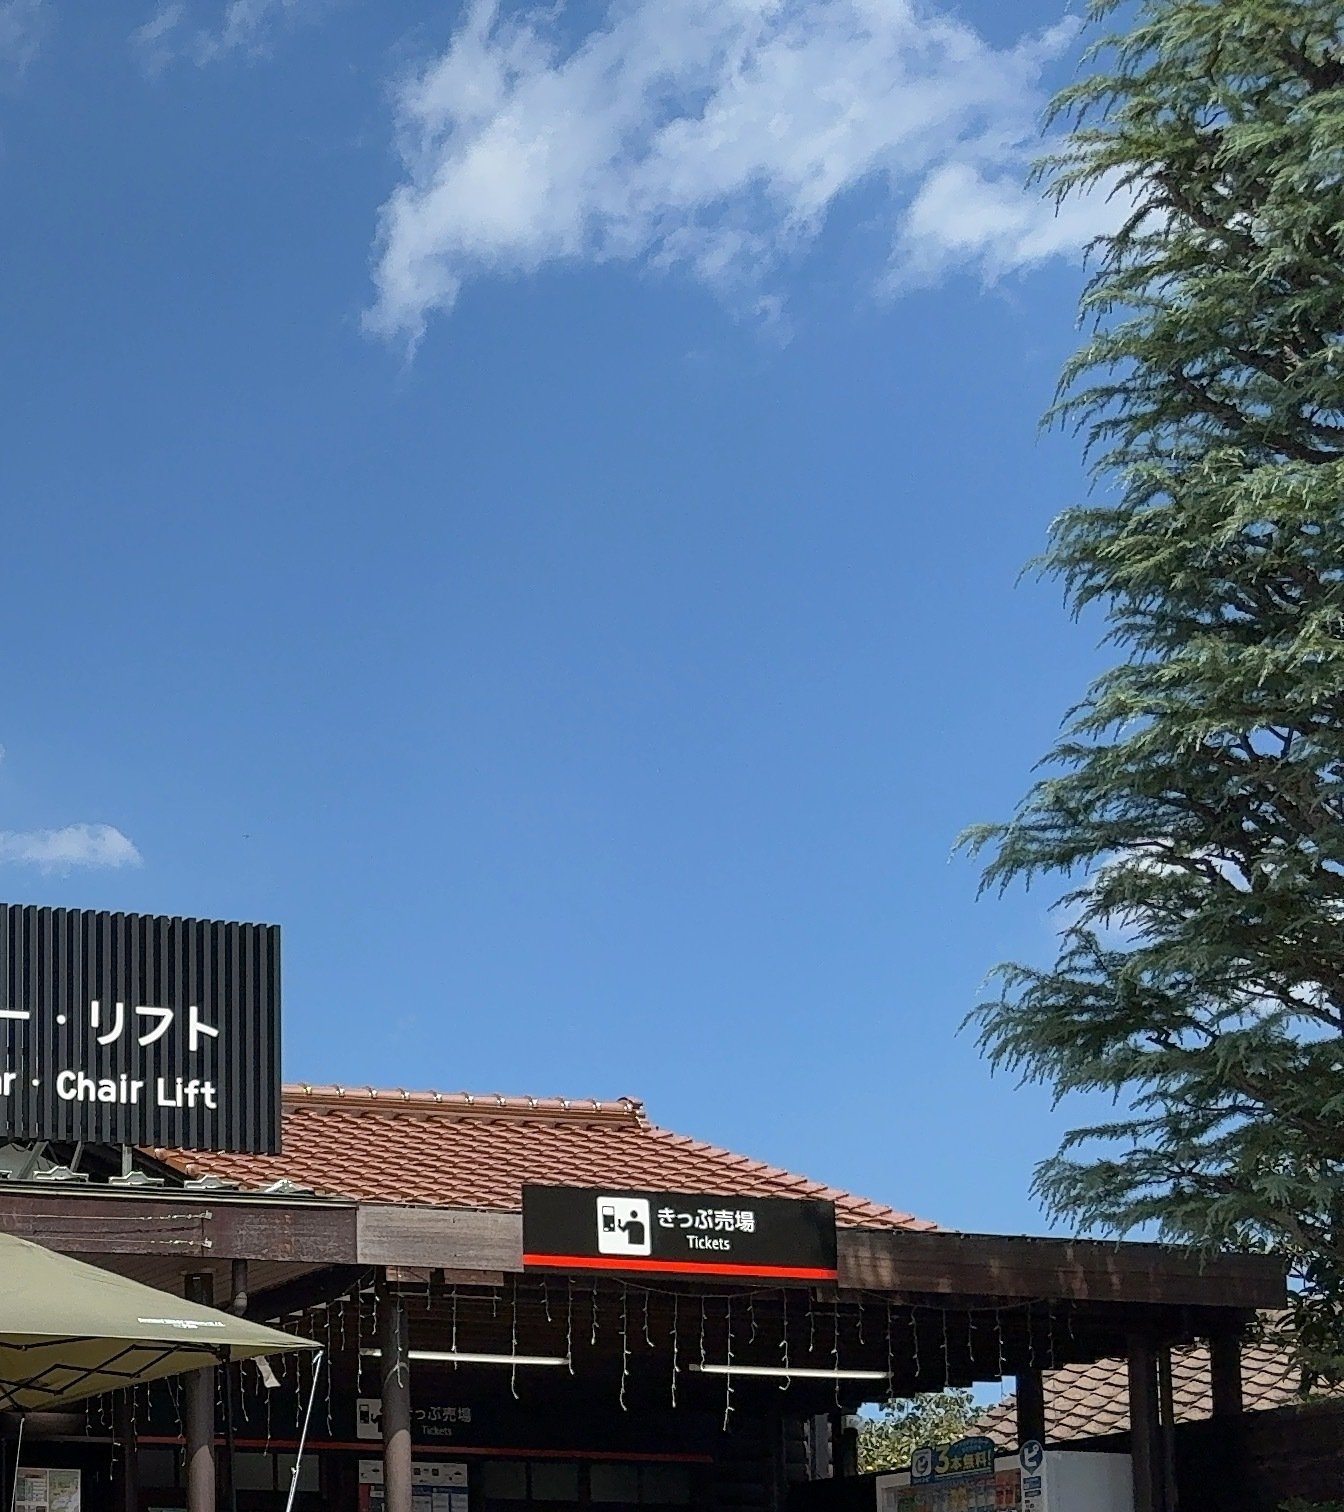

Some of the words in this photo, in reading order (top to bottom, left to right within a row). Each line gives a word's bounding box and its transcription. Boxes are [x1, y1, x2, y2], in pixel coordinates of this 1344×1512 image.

[56, 1070, 142, 1104] Chair
[158, 1076, 216, 1109] Lift
[658, 1207, 755, 1232] きっぷ売場
[686, 1235, 730, 1250] Tickets
[410, 1406, 471, 1423] っぷ売場
